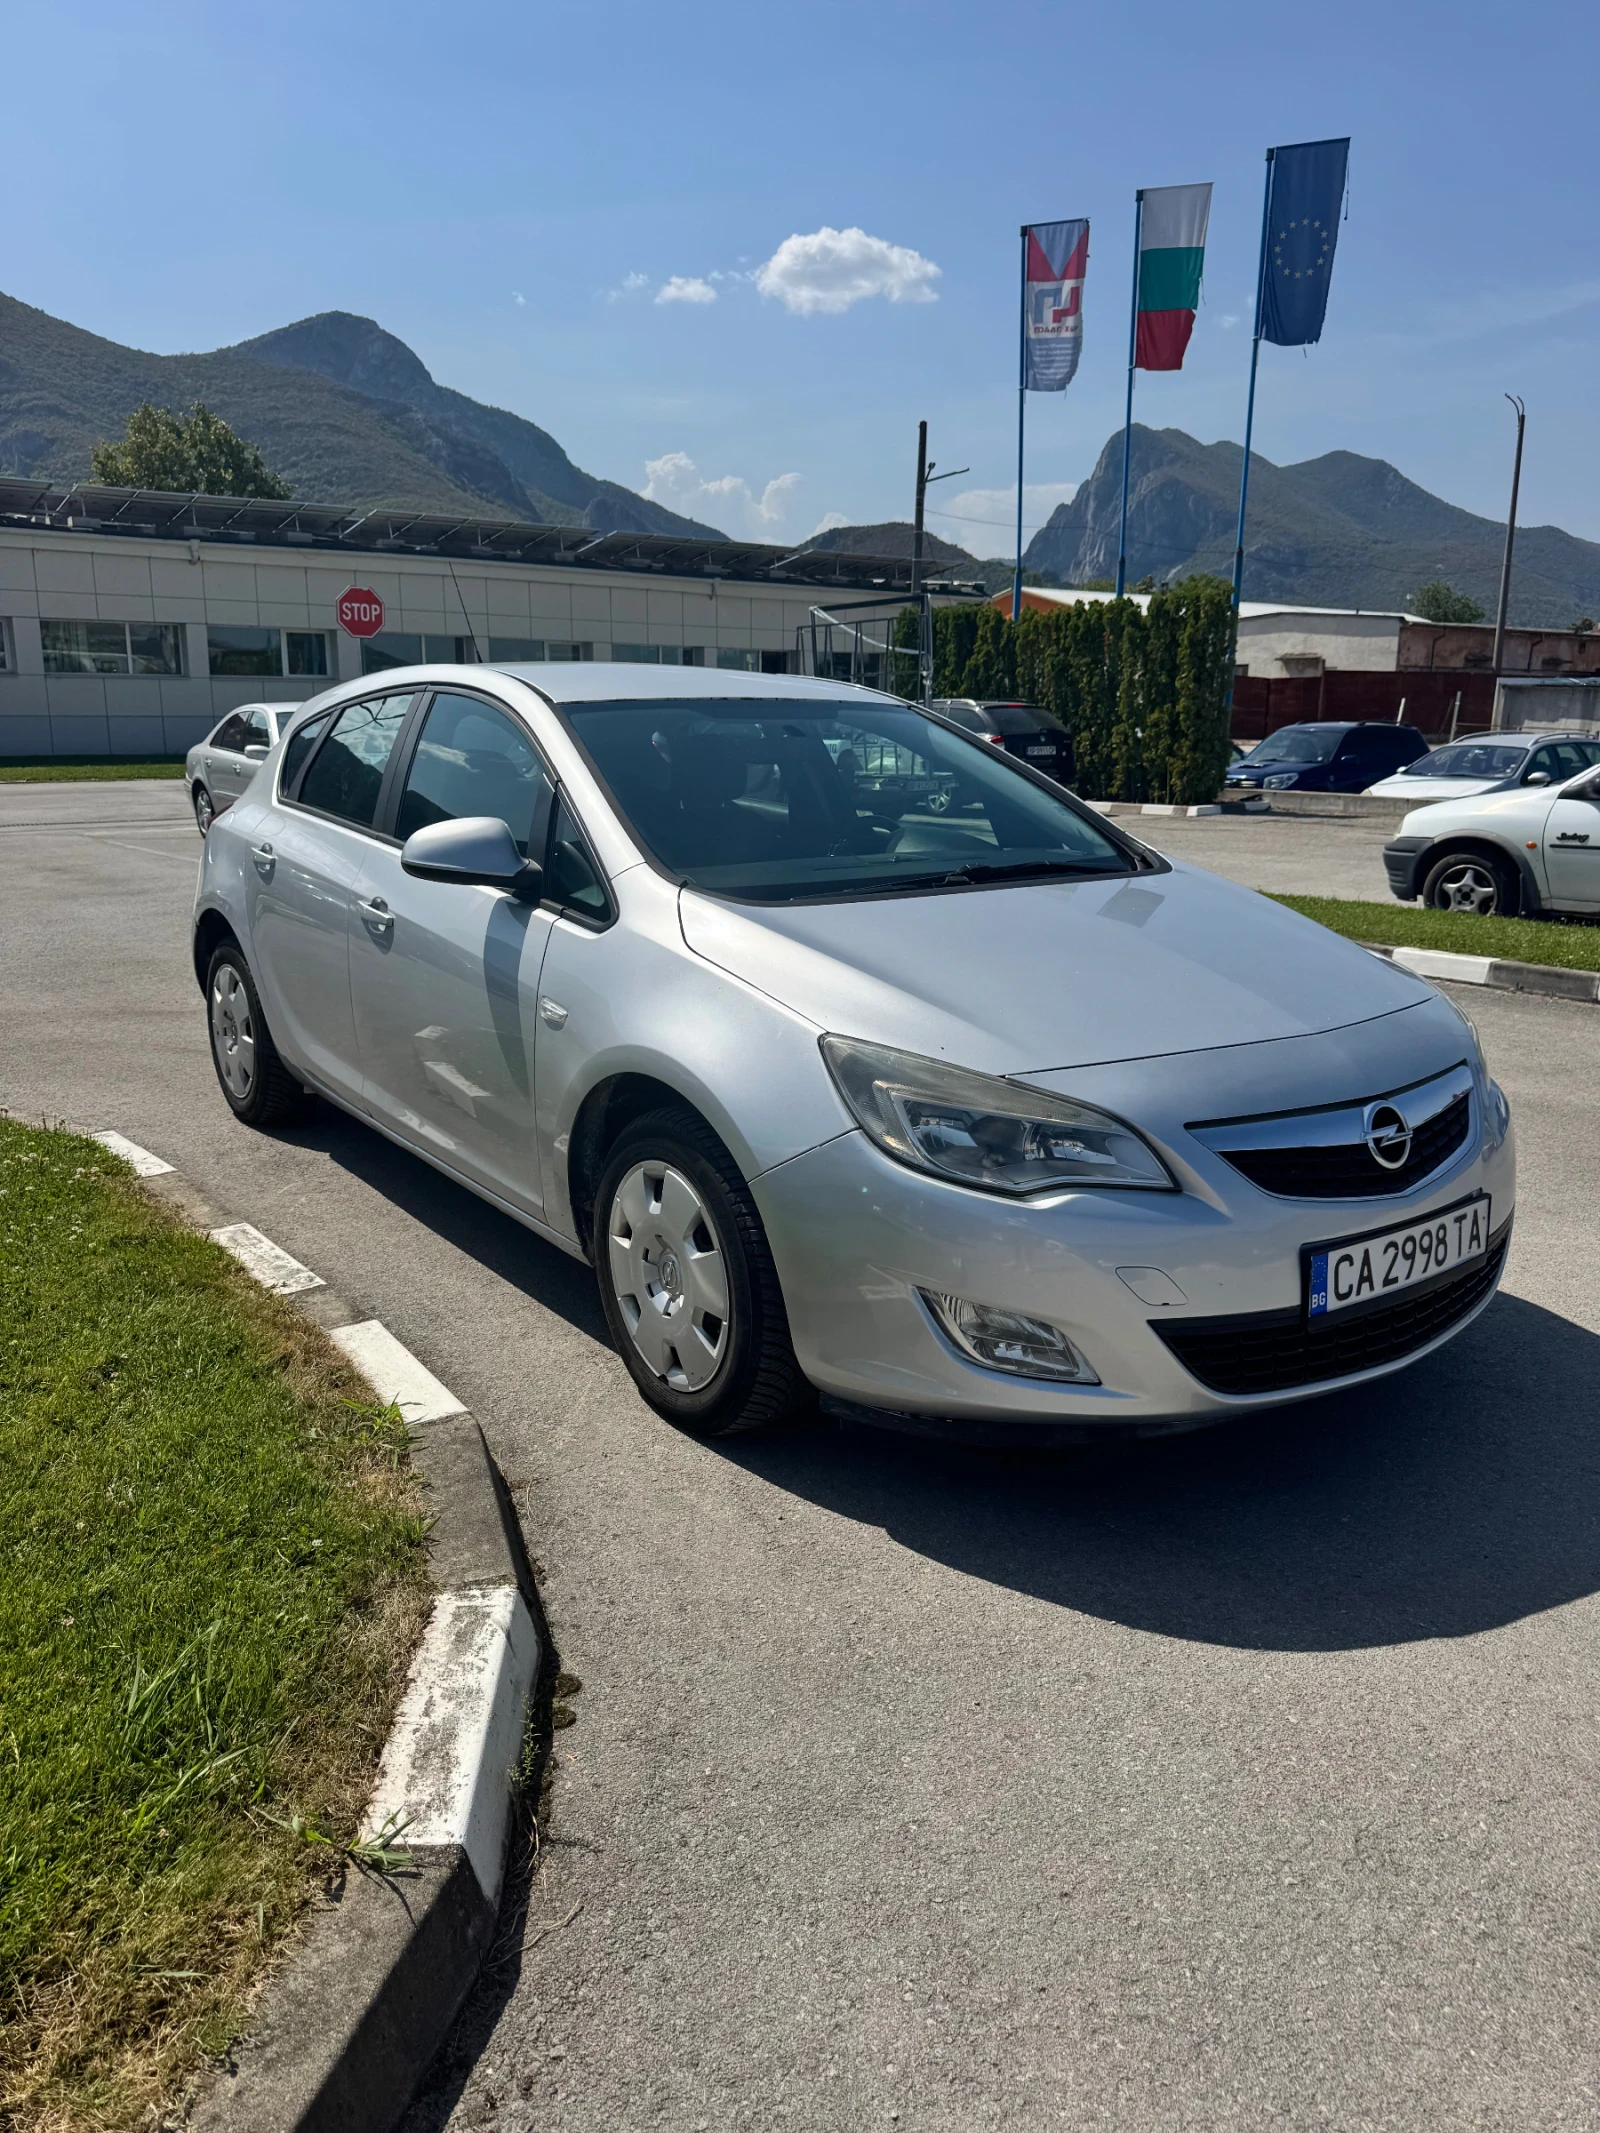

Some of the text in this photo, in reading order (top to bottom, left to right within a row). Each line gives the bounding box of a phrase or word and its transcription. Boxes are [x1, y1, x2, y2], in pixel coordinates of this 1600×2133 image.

[342, 603, 380, 622] STOP
[1556, 832, 1589, 843] Swing
[1333, 1209, 1481, 1302] CA 2998 TA
[1311, 1291, 1326, 1308] BG
